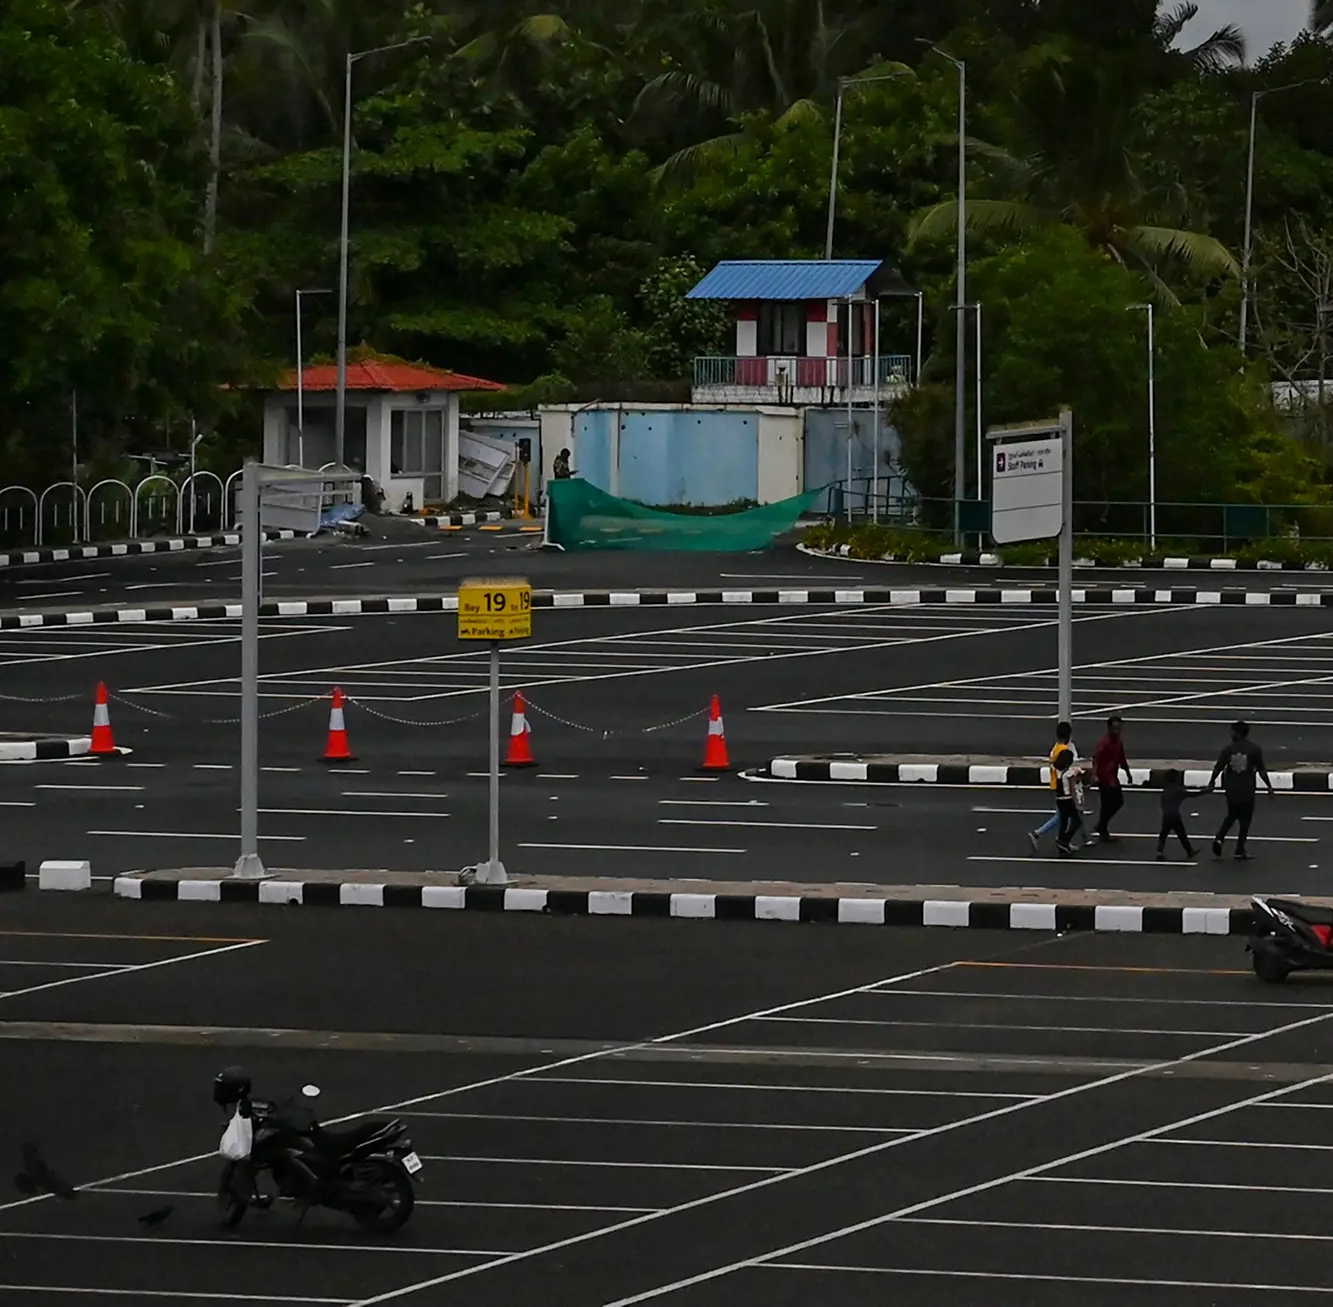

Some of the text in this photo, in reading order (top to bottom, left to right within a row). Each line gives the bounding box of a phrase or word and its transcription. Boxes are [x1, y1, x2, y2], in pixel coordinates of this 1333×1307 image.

[483, 593, 506, 612] 19
[520, 591, 530, 610] 19
[471, 626, 505, 637] Parking
